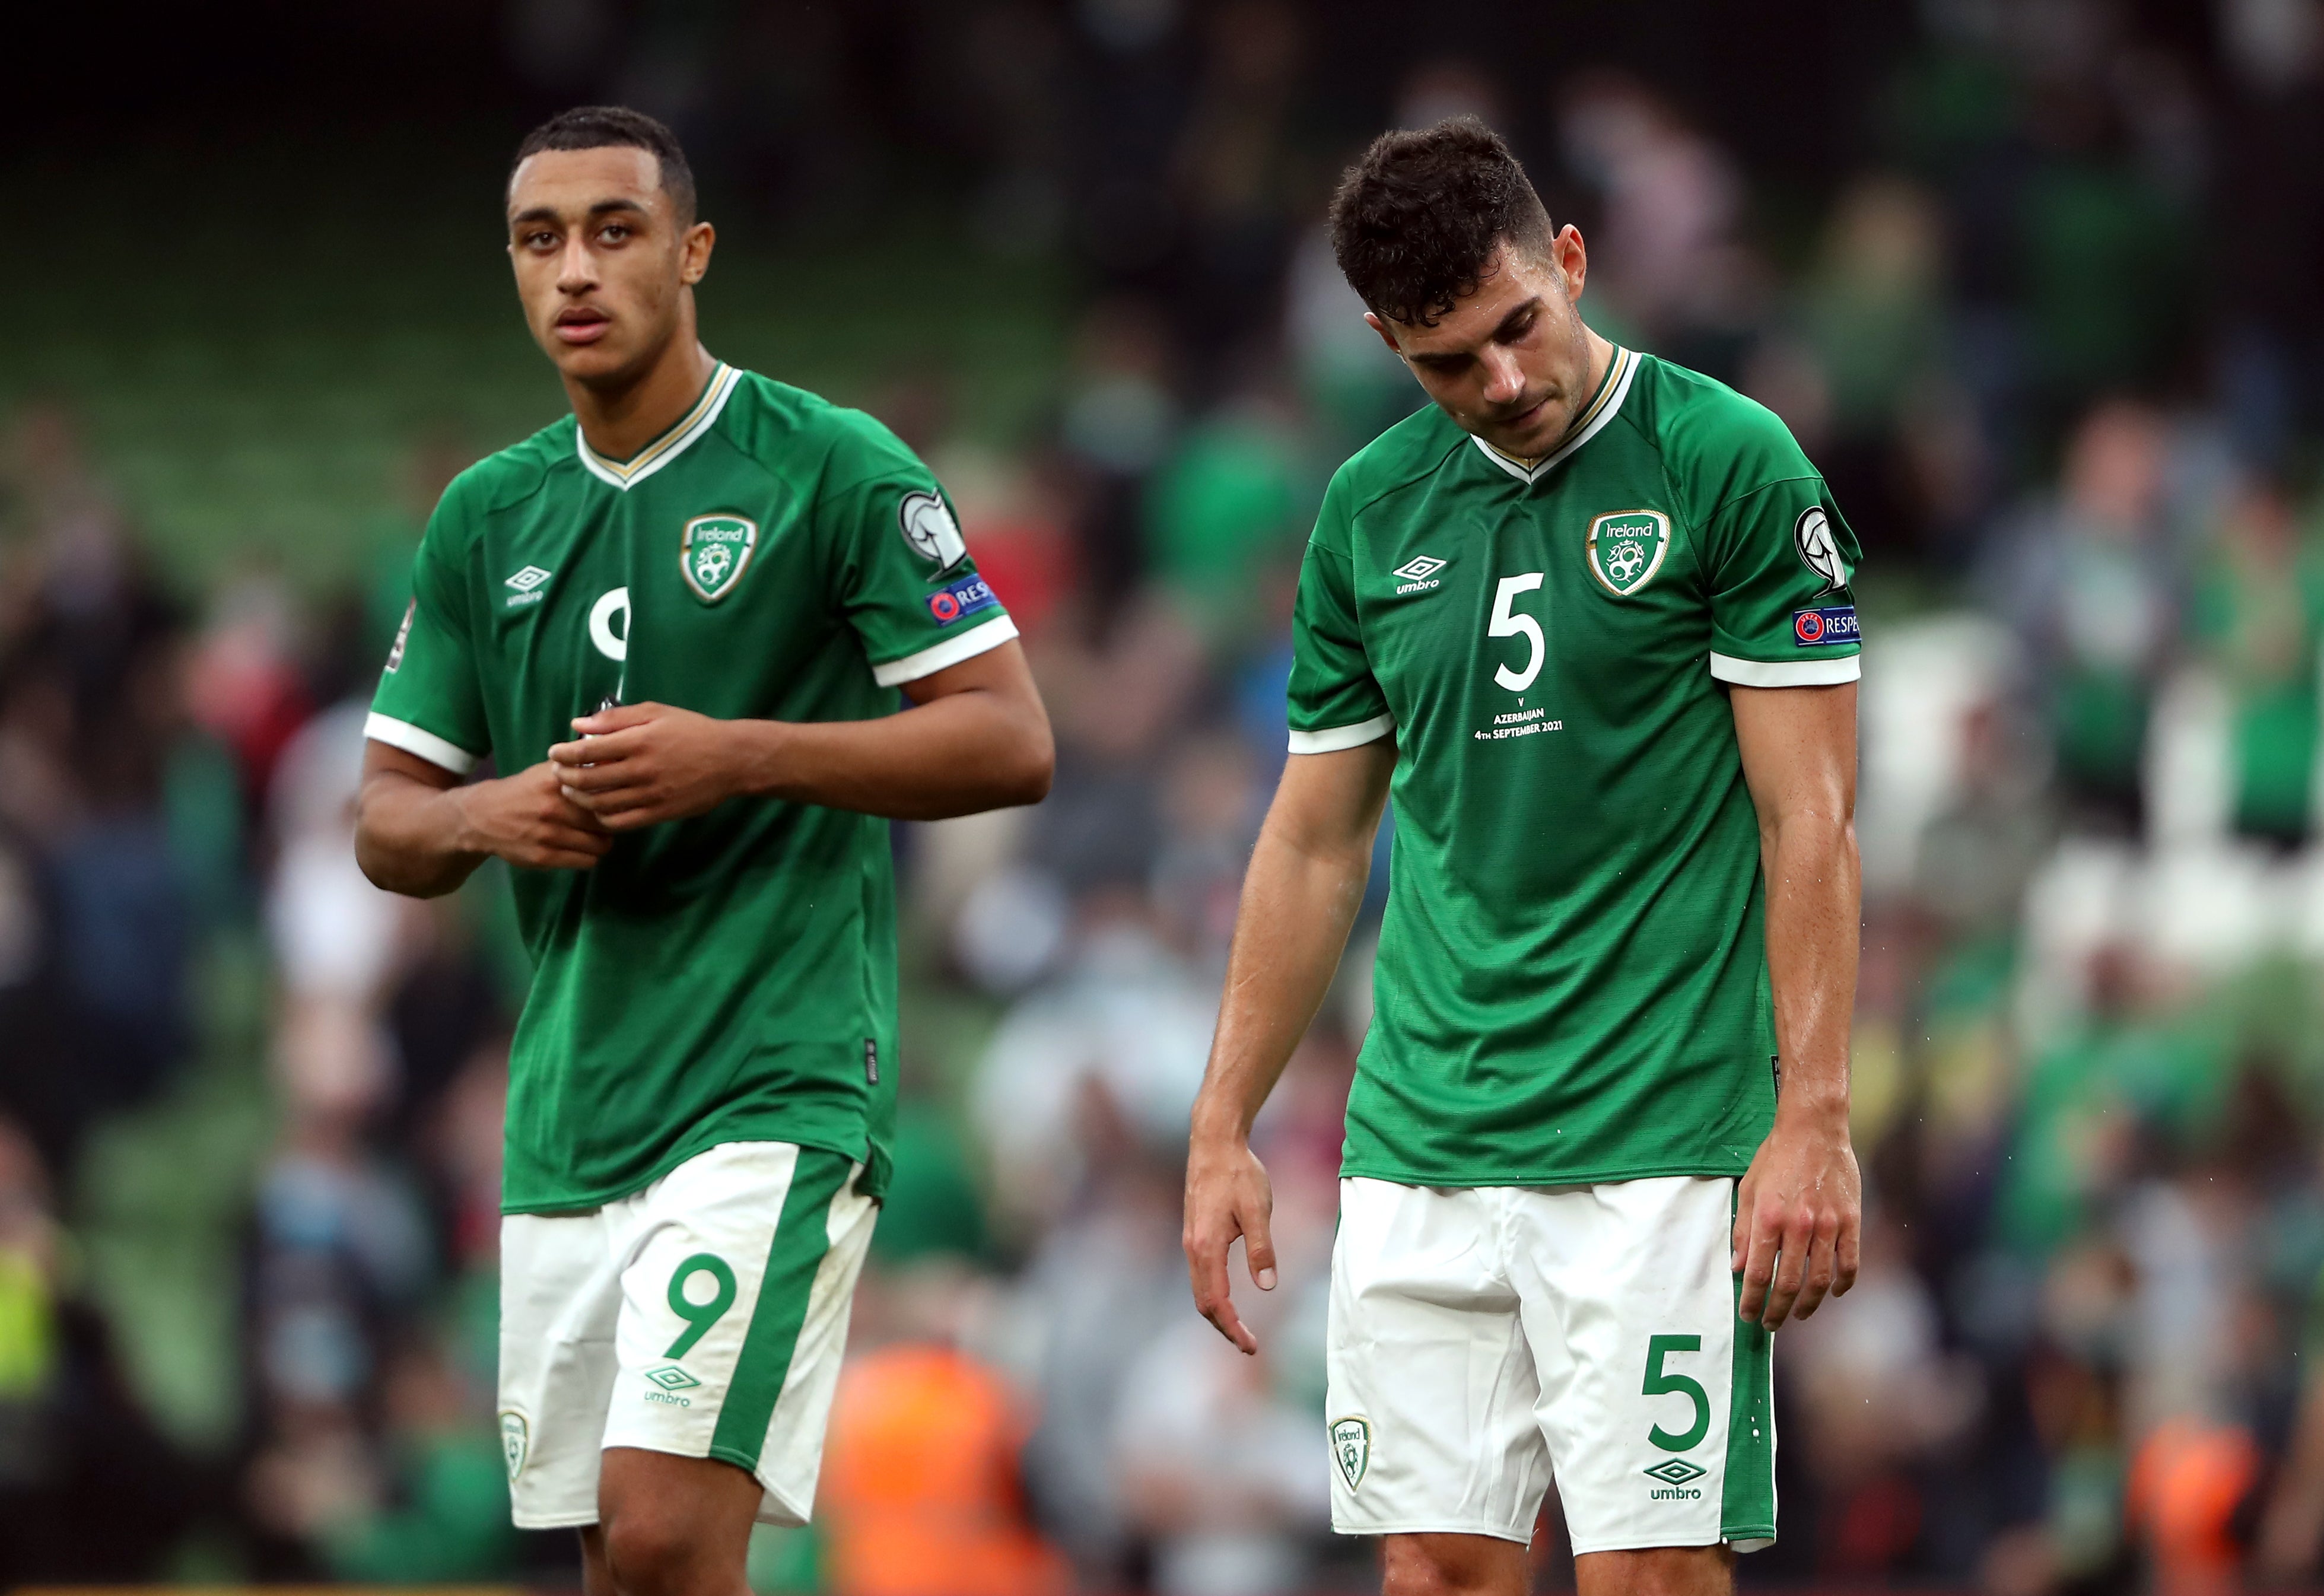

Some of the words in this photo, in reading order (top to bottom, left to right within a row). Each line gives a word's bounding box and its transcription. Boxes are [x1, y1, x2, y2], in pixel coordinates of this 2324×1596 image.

[697, 526, 744, 542] Ireland
[1606, 522, 1653, 537] Ireland
[1396, 579, 1440, 594] umbro
[1488, 573, 1545, 692] 5
[1493, 708, 1544, 724] AZERBAIJAN
[1493, 723, 1540, 739] SEPTEMBER
[1541, 720, 1562, 732] 2021
[662, 1252, 737, 1360] 9
[644, 1391, 691, 1407] umbro
[1642, 1335, 1710, 1452] 5
[1336, 1428, 1360, 1441] Ireland
[1651, 1487, 1701, 1500] umbro
